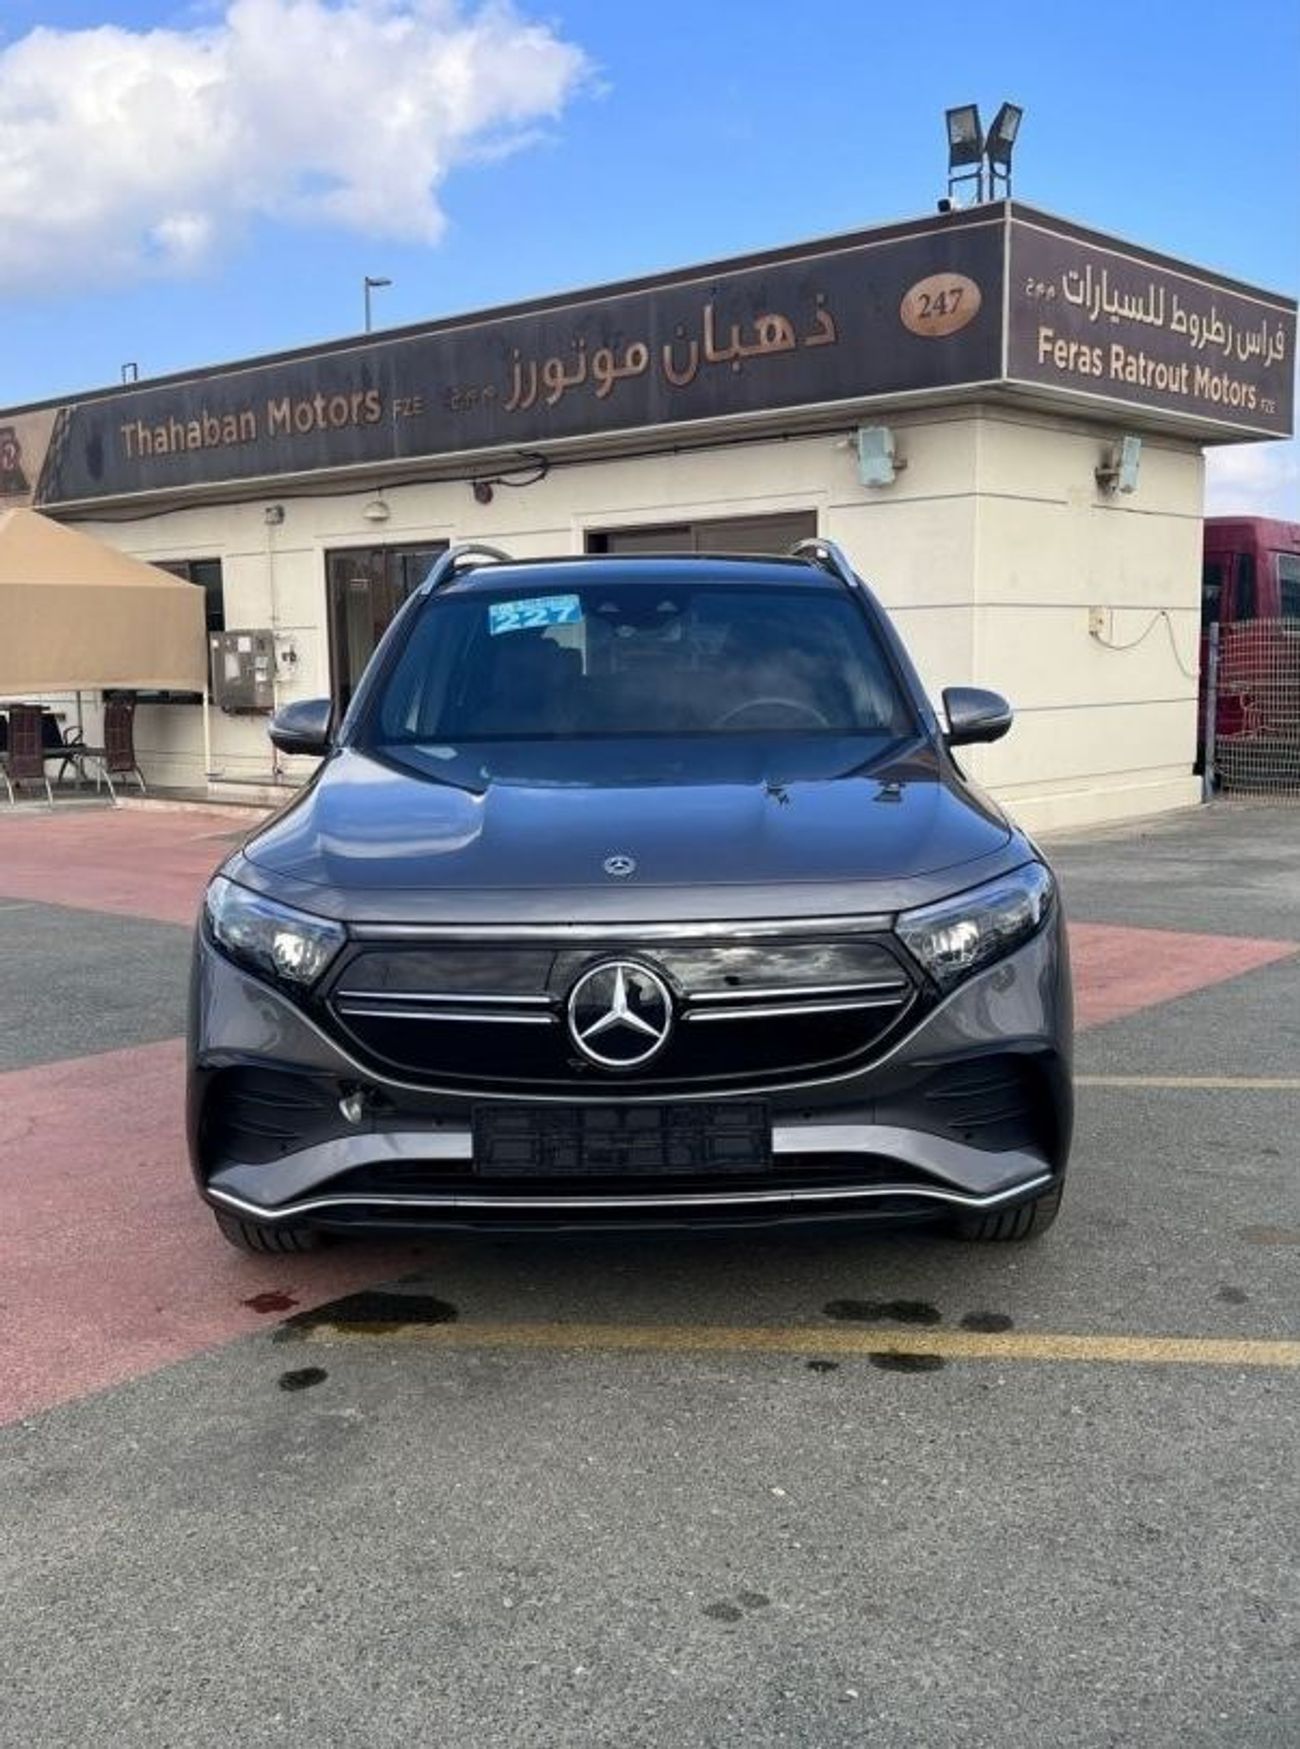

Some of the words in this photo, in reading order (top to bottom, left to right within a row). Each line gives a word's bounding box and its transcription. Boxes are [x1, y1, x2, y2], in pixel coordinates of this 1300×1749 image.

[918, 288, 964, 319] 247
[1062, 265, 1164, 325] للسيارات
[662, 293, 838, 387] ذهبان
[1038, 326, 1103, 377] Feras
[1109, 343, 1188, 395] Ratrout
[1194, 363, 1256, 410] Motors
[1236, 319, 1285, 367] فراس
[502, 336, 650, 412] موتورز
[120, 408, 257, 459] Thahaban
[267, 389, 382, 437] Motors
[491, 604, 576, 635] 227
